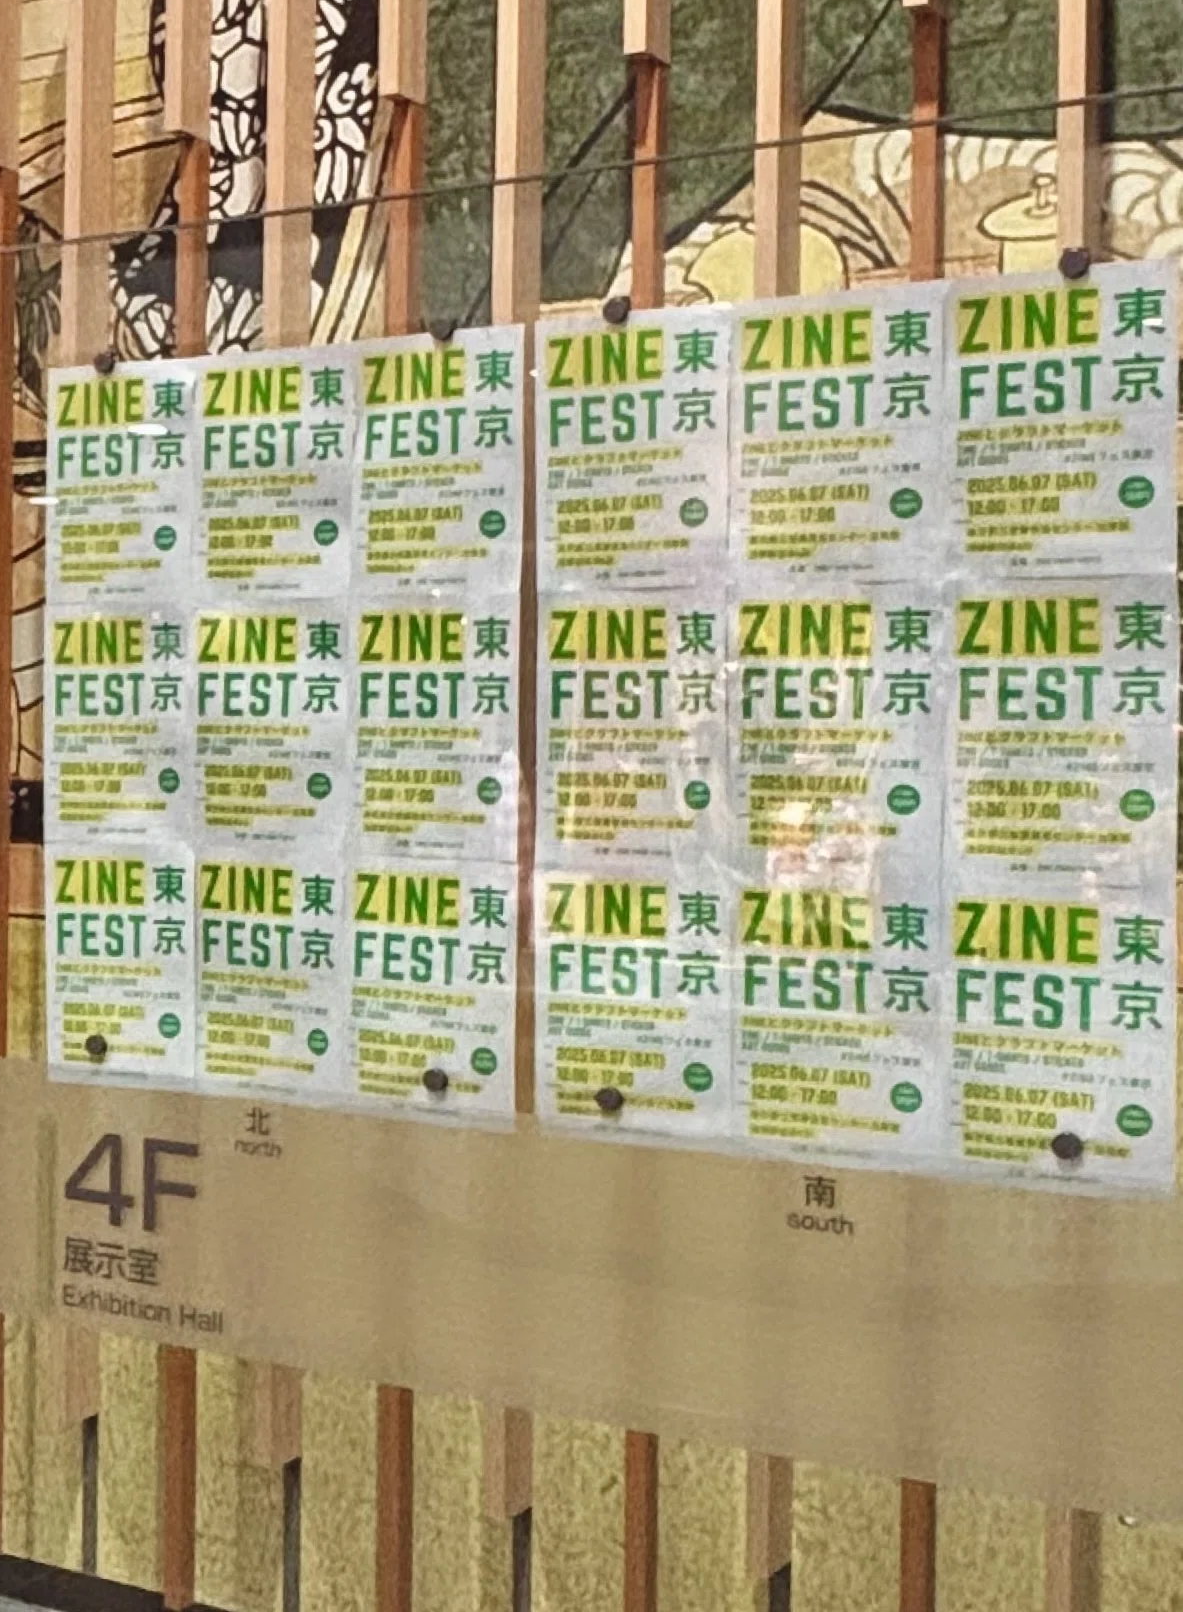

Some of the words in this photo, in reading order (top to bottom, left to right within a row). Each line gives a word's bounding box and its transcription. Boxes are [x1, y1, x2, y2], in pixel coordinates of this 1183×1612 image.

[742, 310, 872, 371] ZINE
[958, 288, 1099, 354] ZINE
[1111, 287, 1167, 403] 東京
[364, 348, 465, 404] ZINE
[547, 329, 663, 388] ZINE
[672, 328, 719, 433] 東京
[882, 308, 932, 419] 東京
[57, 378, 144, 427] ZINE
[203, 365, 301, 417] ZINE
[306, 366, 345, 461] 東京
[473, 348, 514, 448] 東京
[743, 374, 874, 434] FEST
[959, 355, 1103, 420] FEST
[151, 378, 186, 470] 東京
[203, 421, 302, 470] FEST
[364, 407, 468, 461] FEST
[549, 389, 664, 447] FEST
[57, 433, 144, 479] FEST
[54, 619, 144, 665] ZINE
[197, 617, 297, 663] ZINE
[359, 612, 464, 662] ZINE
[549, 608, 667, 660] ZINE
[739, 603, 871, 657] ZINE
[958, 598, 1100, 655] ZINE
[150, 620, 184, 712] 東京
[301, 619, 342, 714] 東京
[471, 616, 511, 716] 東京
[676, 610, 717, 715] 東京
[882, 605, 932, 716] 東京
[1111, 600, 1167, 716] 東京
[54, 672, 145, 717] FEST
[197, 671, 298, 718] FEST
[359, 671, 465, 719] FEST
[550, 669, 669, 720] FEST
[741, 667, 874, 720] FEST
[958, 665, 1104, 721] FEST
[54, 859, 145, 905] ZINE
[151, 864, 187, 956] 東京
[200, 864, 293, 916] ZINE
[353, 872, 461, 928] ZINE
[547, 882, 667, 936] ZINE
[56, 912, 147, 959] FEST
[202, 918, 294, 971] FEST
[300, 873, 336, 970] 東京
[466, 885, 509, 985] 東京
[675, 890, 722, 997] 東京
[742, 890, 871, 950] ZINE
[953, 901, 1099, 965] ZINE
[353, 930, 461, 986] FEST
[548, 942, 669, 999] FEST
[743, 954, 874, 1015] FEST
[881, 902, 932, 1013] 東京
[1110, 914, 1166, 1032] 東京
[956, 968, 1102, 1033] FEST
[234, 1138, 283, 1160] north
[244, 1106, 271, 1136] 北
[64, 1132, 200, 1233] 4F
[803, 1174, 837, 1209] 南
[786, 1211, 855, 1236] south
[63, 1236, 160, 1287] 展示室
[62, 1283, 172, 1328] Exhibition
[178, 1303, 224, 1335] Hall
